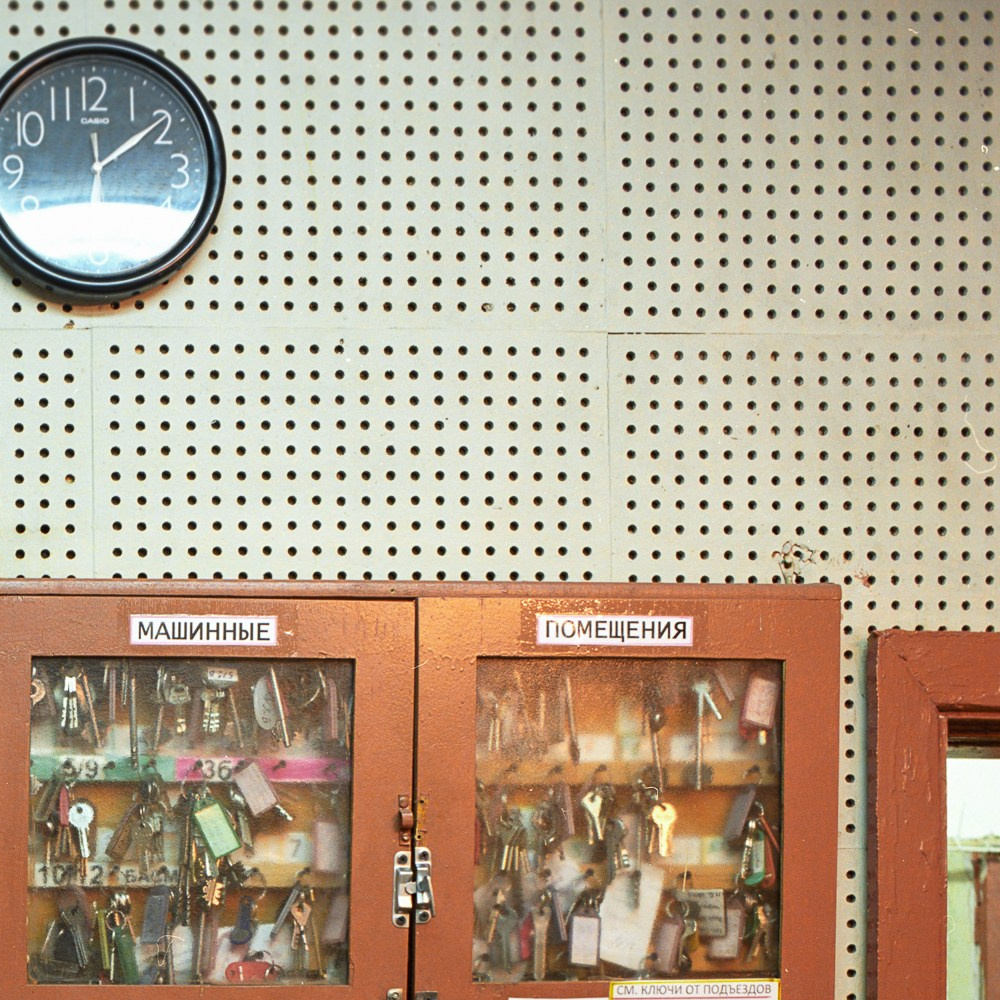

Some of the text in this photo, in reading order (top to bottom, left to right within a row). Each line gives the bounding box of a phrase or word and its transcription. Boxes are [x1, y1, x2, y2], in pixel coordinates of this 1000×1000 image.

[51, 86, 70, 121] 11
[82, 76, 108, 111] 12
[130, 86, 135, 121] 1
[17, 111, 44, 147] 10
[152, 109, 173, 144] 2
[3, 154, 24, 190] 9
[170, 153, 189, 188] 3
[138, 621, 271, 641] МАШИННЫЕ
[545, 620, 687, 640] ПОМЕЩЕНИЯ
[617, 984, 771, 995] СМ. КЛЮЧИ ОТ ПОДЪЕЗДОВ
